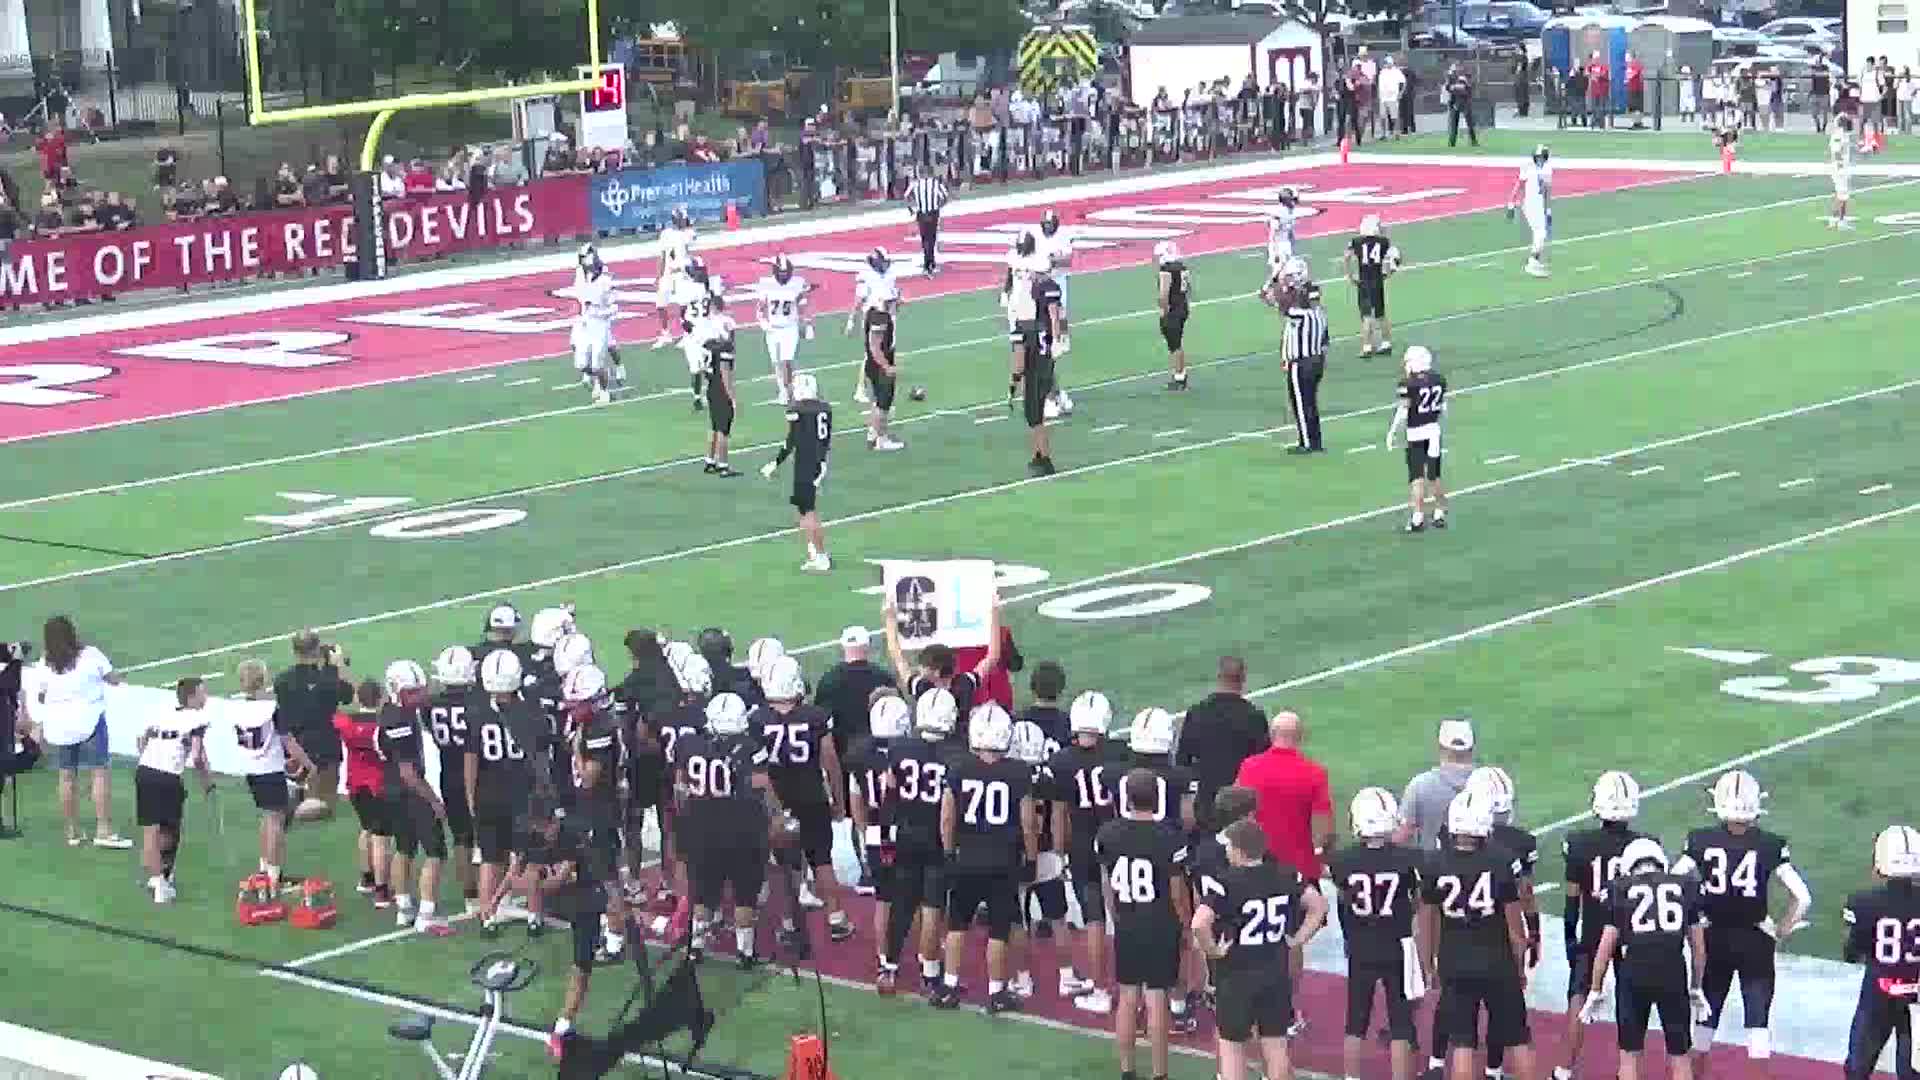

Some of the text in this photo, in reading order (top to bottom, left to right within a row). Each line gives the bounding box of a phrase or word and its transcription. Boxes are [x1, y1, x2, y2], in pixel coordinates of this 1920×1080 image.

[93, 240, 151, 287] OF
[174, 228, 260, 276] THE
[388, 194, 536, 250] DEVILS
[1361, 242, 1381, 264] 14
[1417, 385, 1442, 414] 22
[816, 411, 829, 440] 6
[430, 707, 467, 746] 65
[763, 722, 810, 763] 75
[688, 755, 733, 797] 90
[900, 758, 946, 803] 33
[961, 779, 1010, 825] 70
[1110, 855, 1156, 903] 48
[1347, 872, 1400, 917] 37
[1436, 870, 1495, 919] 24
[1703, 847, 1757, 897] 34
[1239, 894, 1289, 946] 25
[1627, 883, 1684, 932] 26
